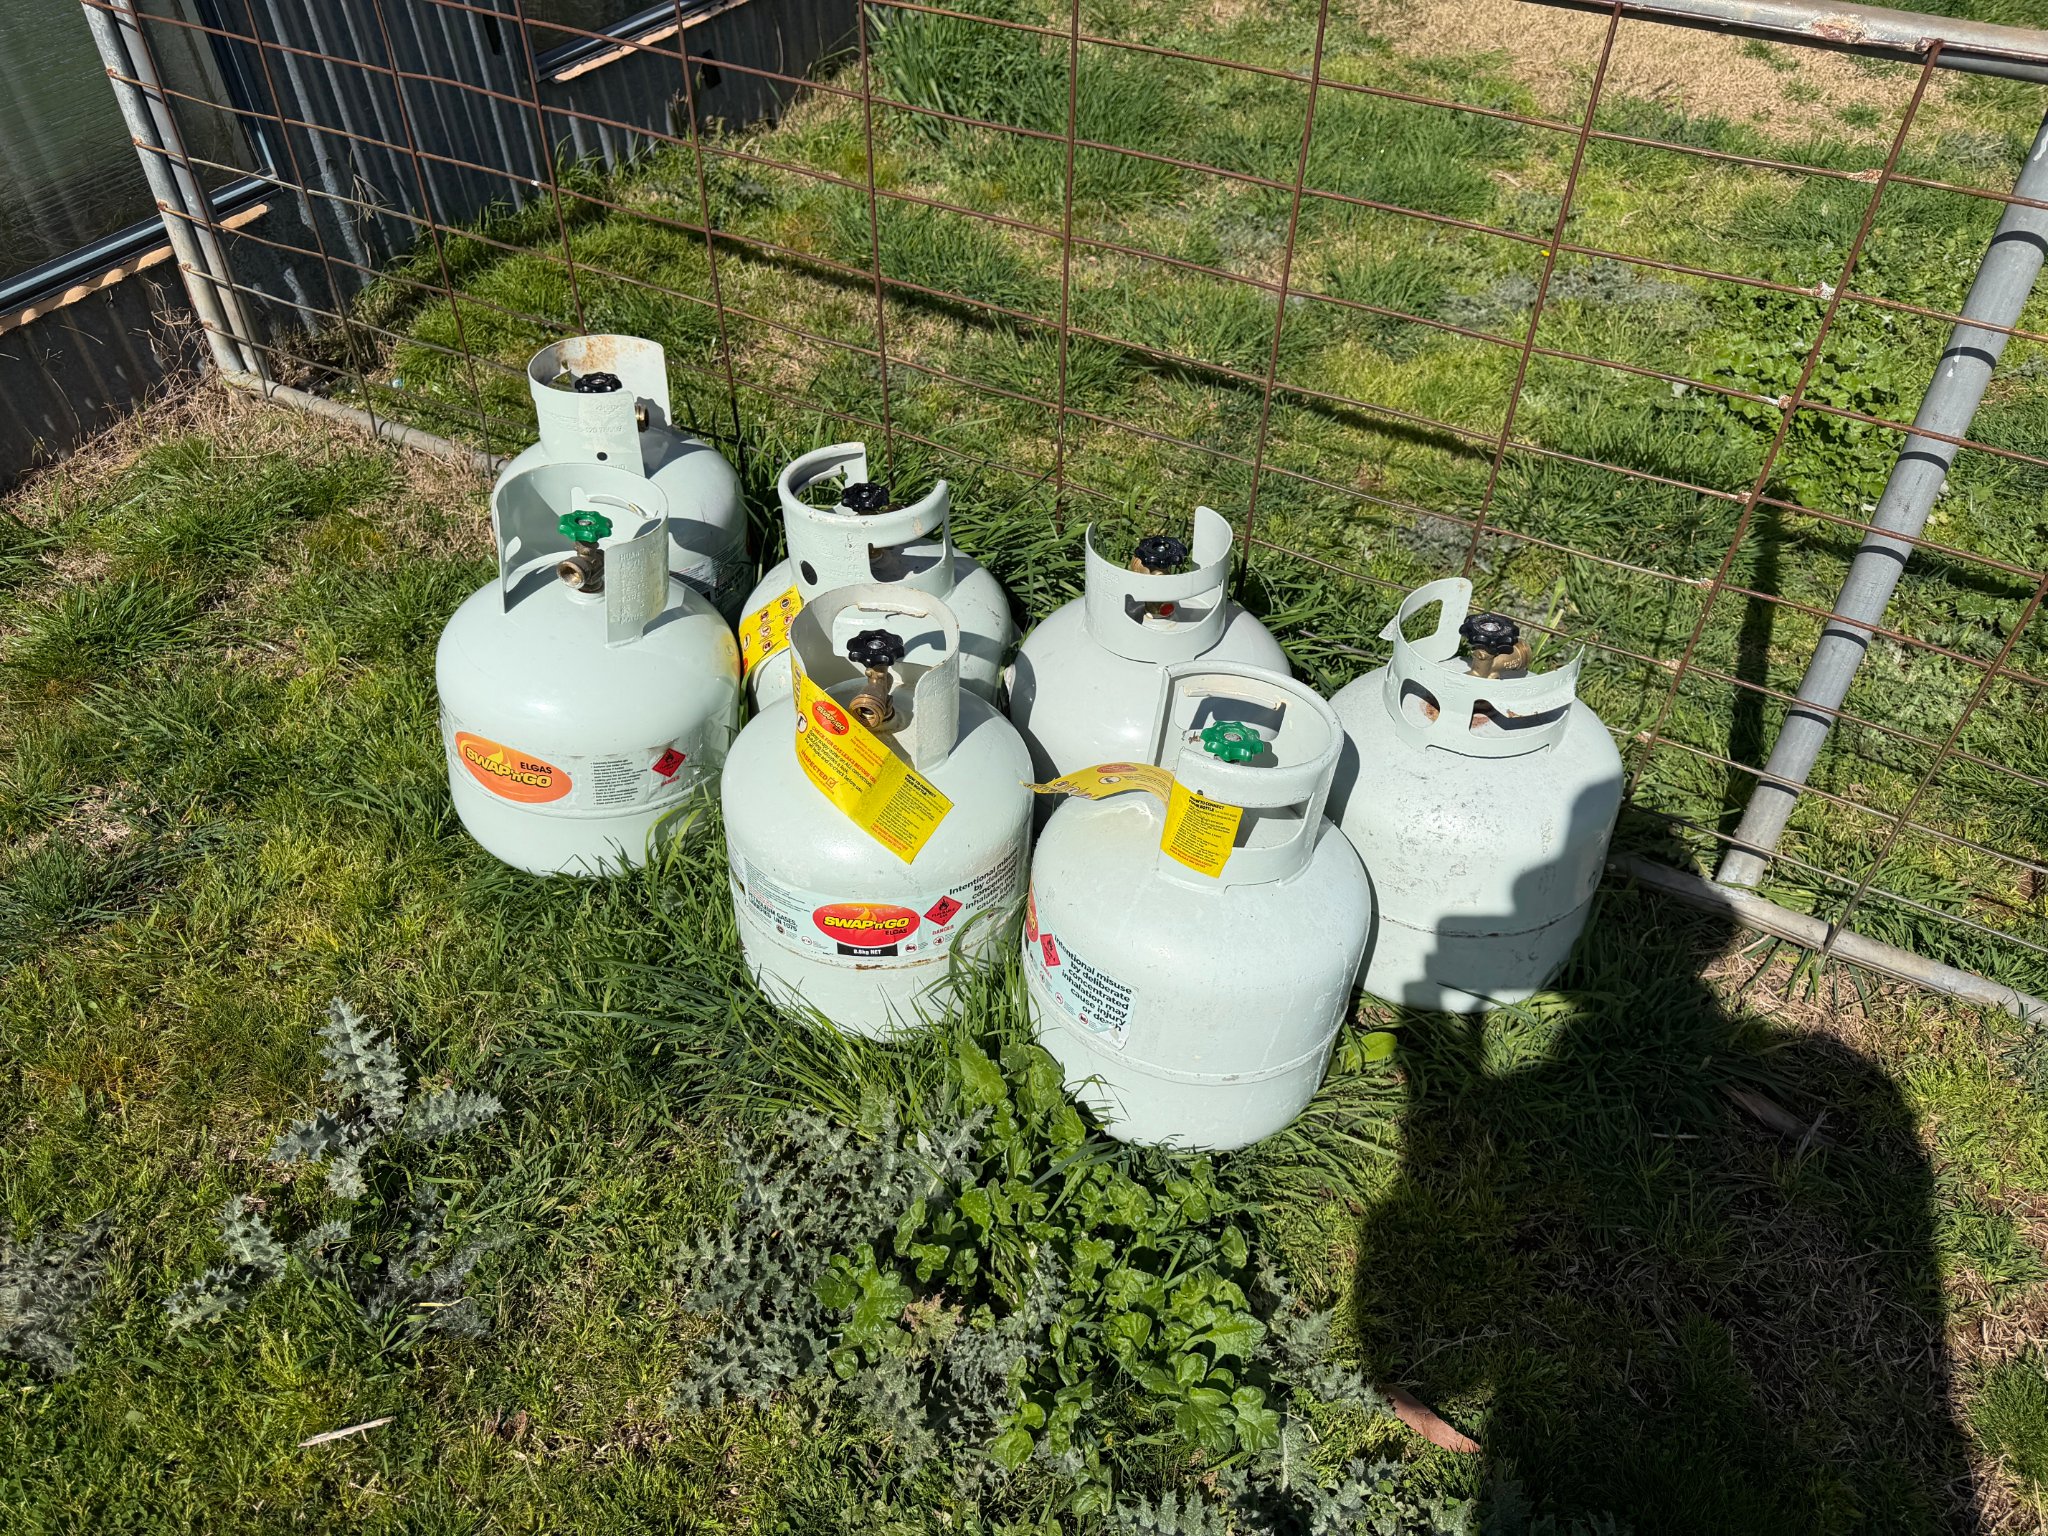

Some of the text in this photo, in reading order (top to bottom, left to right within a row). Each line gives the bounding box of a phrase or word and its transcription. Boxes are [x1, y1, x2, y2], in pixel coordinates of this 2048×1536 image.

[801, 749, 828, 780] INSPECTED
[832, 744, 842, 753] GAS
[840, 751, 855, 764] LEAKS
[520, 761, 552, 775] ELGAS
[949, 866, 996, 895] Intentional
[973, 883, 984, 892] by
[965, 881, 1004, 909] inhalation
[977, 893, 998, 910] cause
[773, 916, 782, 924] UN
[885, 928, 908, 936] ELGAS
[932, 924, 955, 936] DANGER
[1054, 935, 1132, 994] Intentional misuse
[1068, 969, 1129, 1010] concentrated
[1070, 961, 1130, 1002] by deliberate
[1062, 970, 1127, 1018] inhalation may
[1071, 987, 1126, 1026] cause injury
[1082, 1005, 1092, 1014] or
